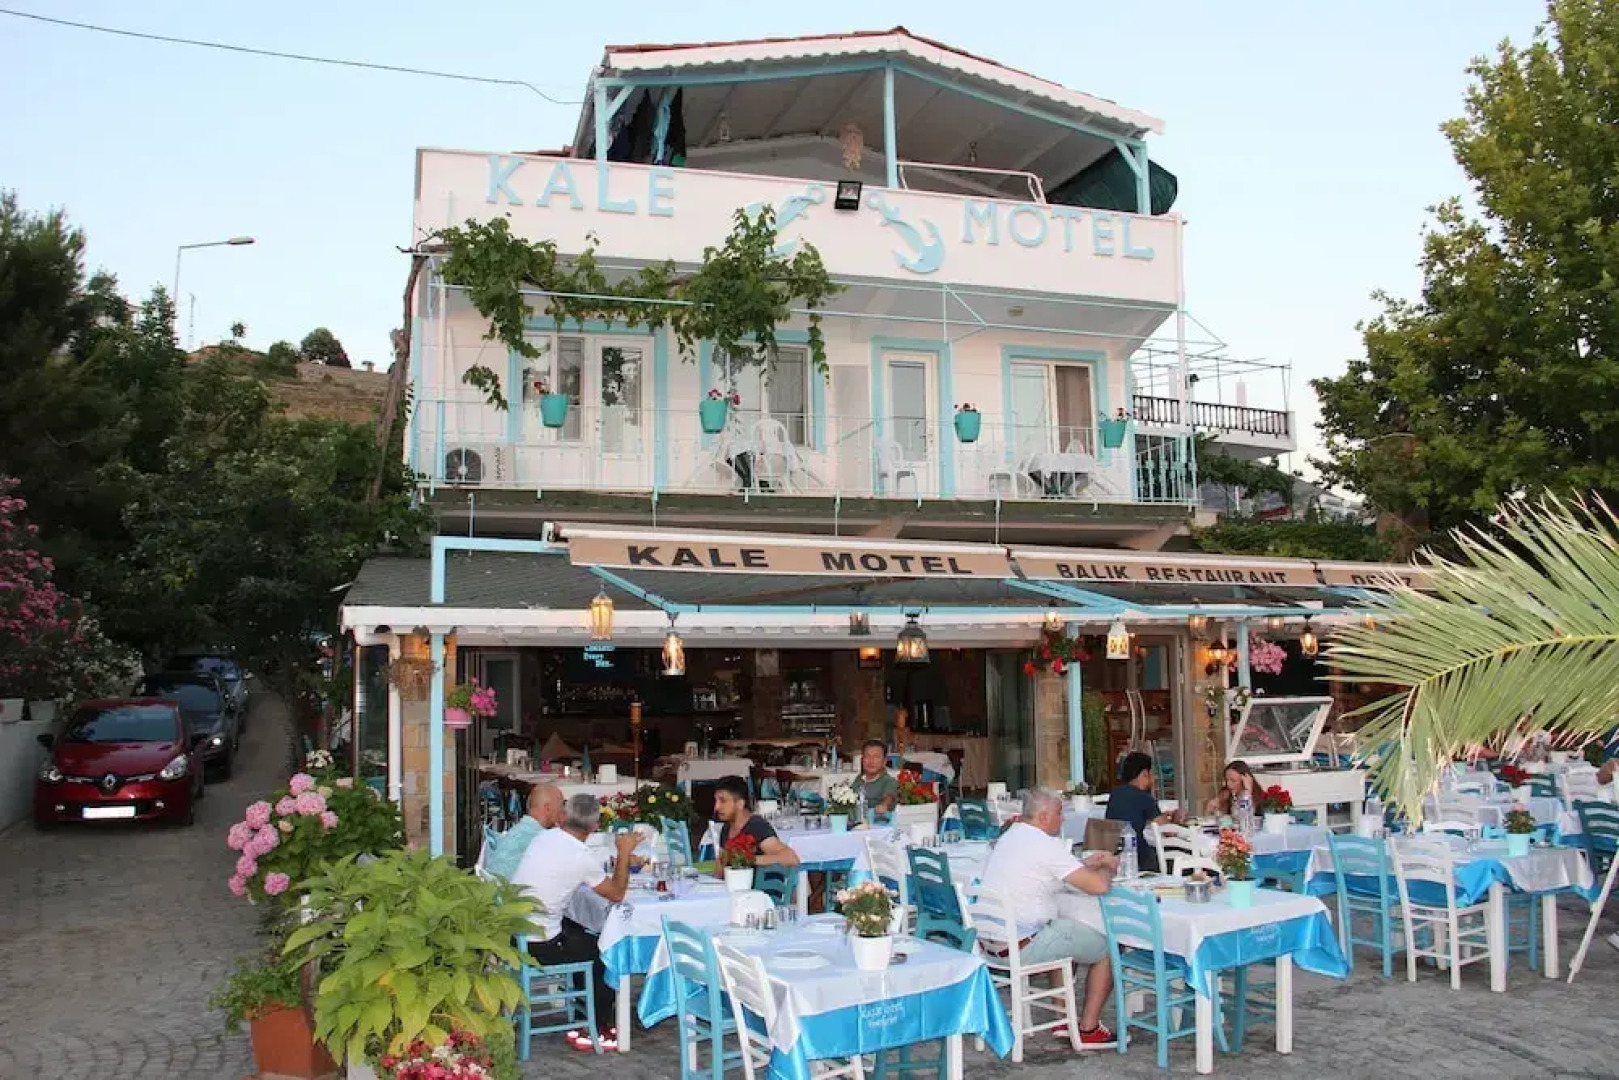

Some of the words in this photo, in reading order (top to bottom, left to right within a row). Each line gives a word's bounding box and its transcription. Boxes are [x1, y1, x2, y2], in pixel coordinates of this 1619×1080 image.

[485, 156, 675, 216] KALE
[963, 201, 1154, 261] MOTEL
[627, 545, 770, 568] KALE
[821, 552, 973, 574] MOTEL
[1056, 563, 1129, 579] BALIK
[1145, 567, 1287, 583] RESTAURANT
